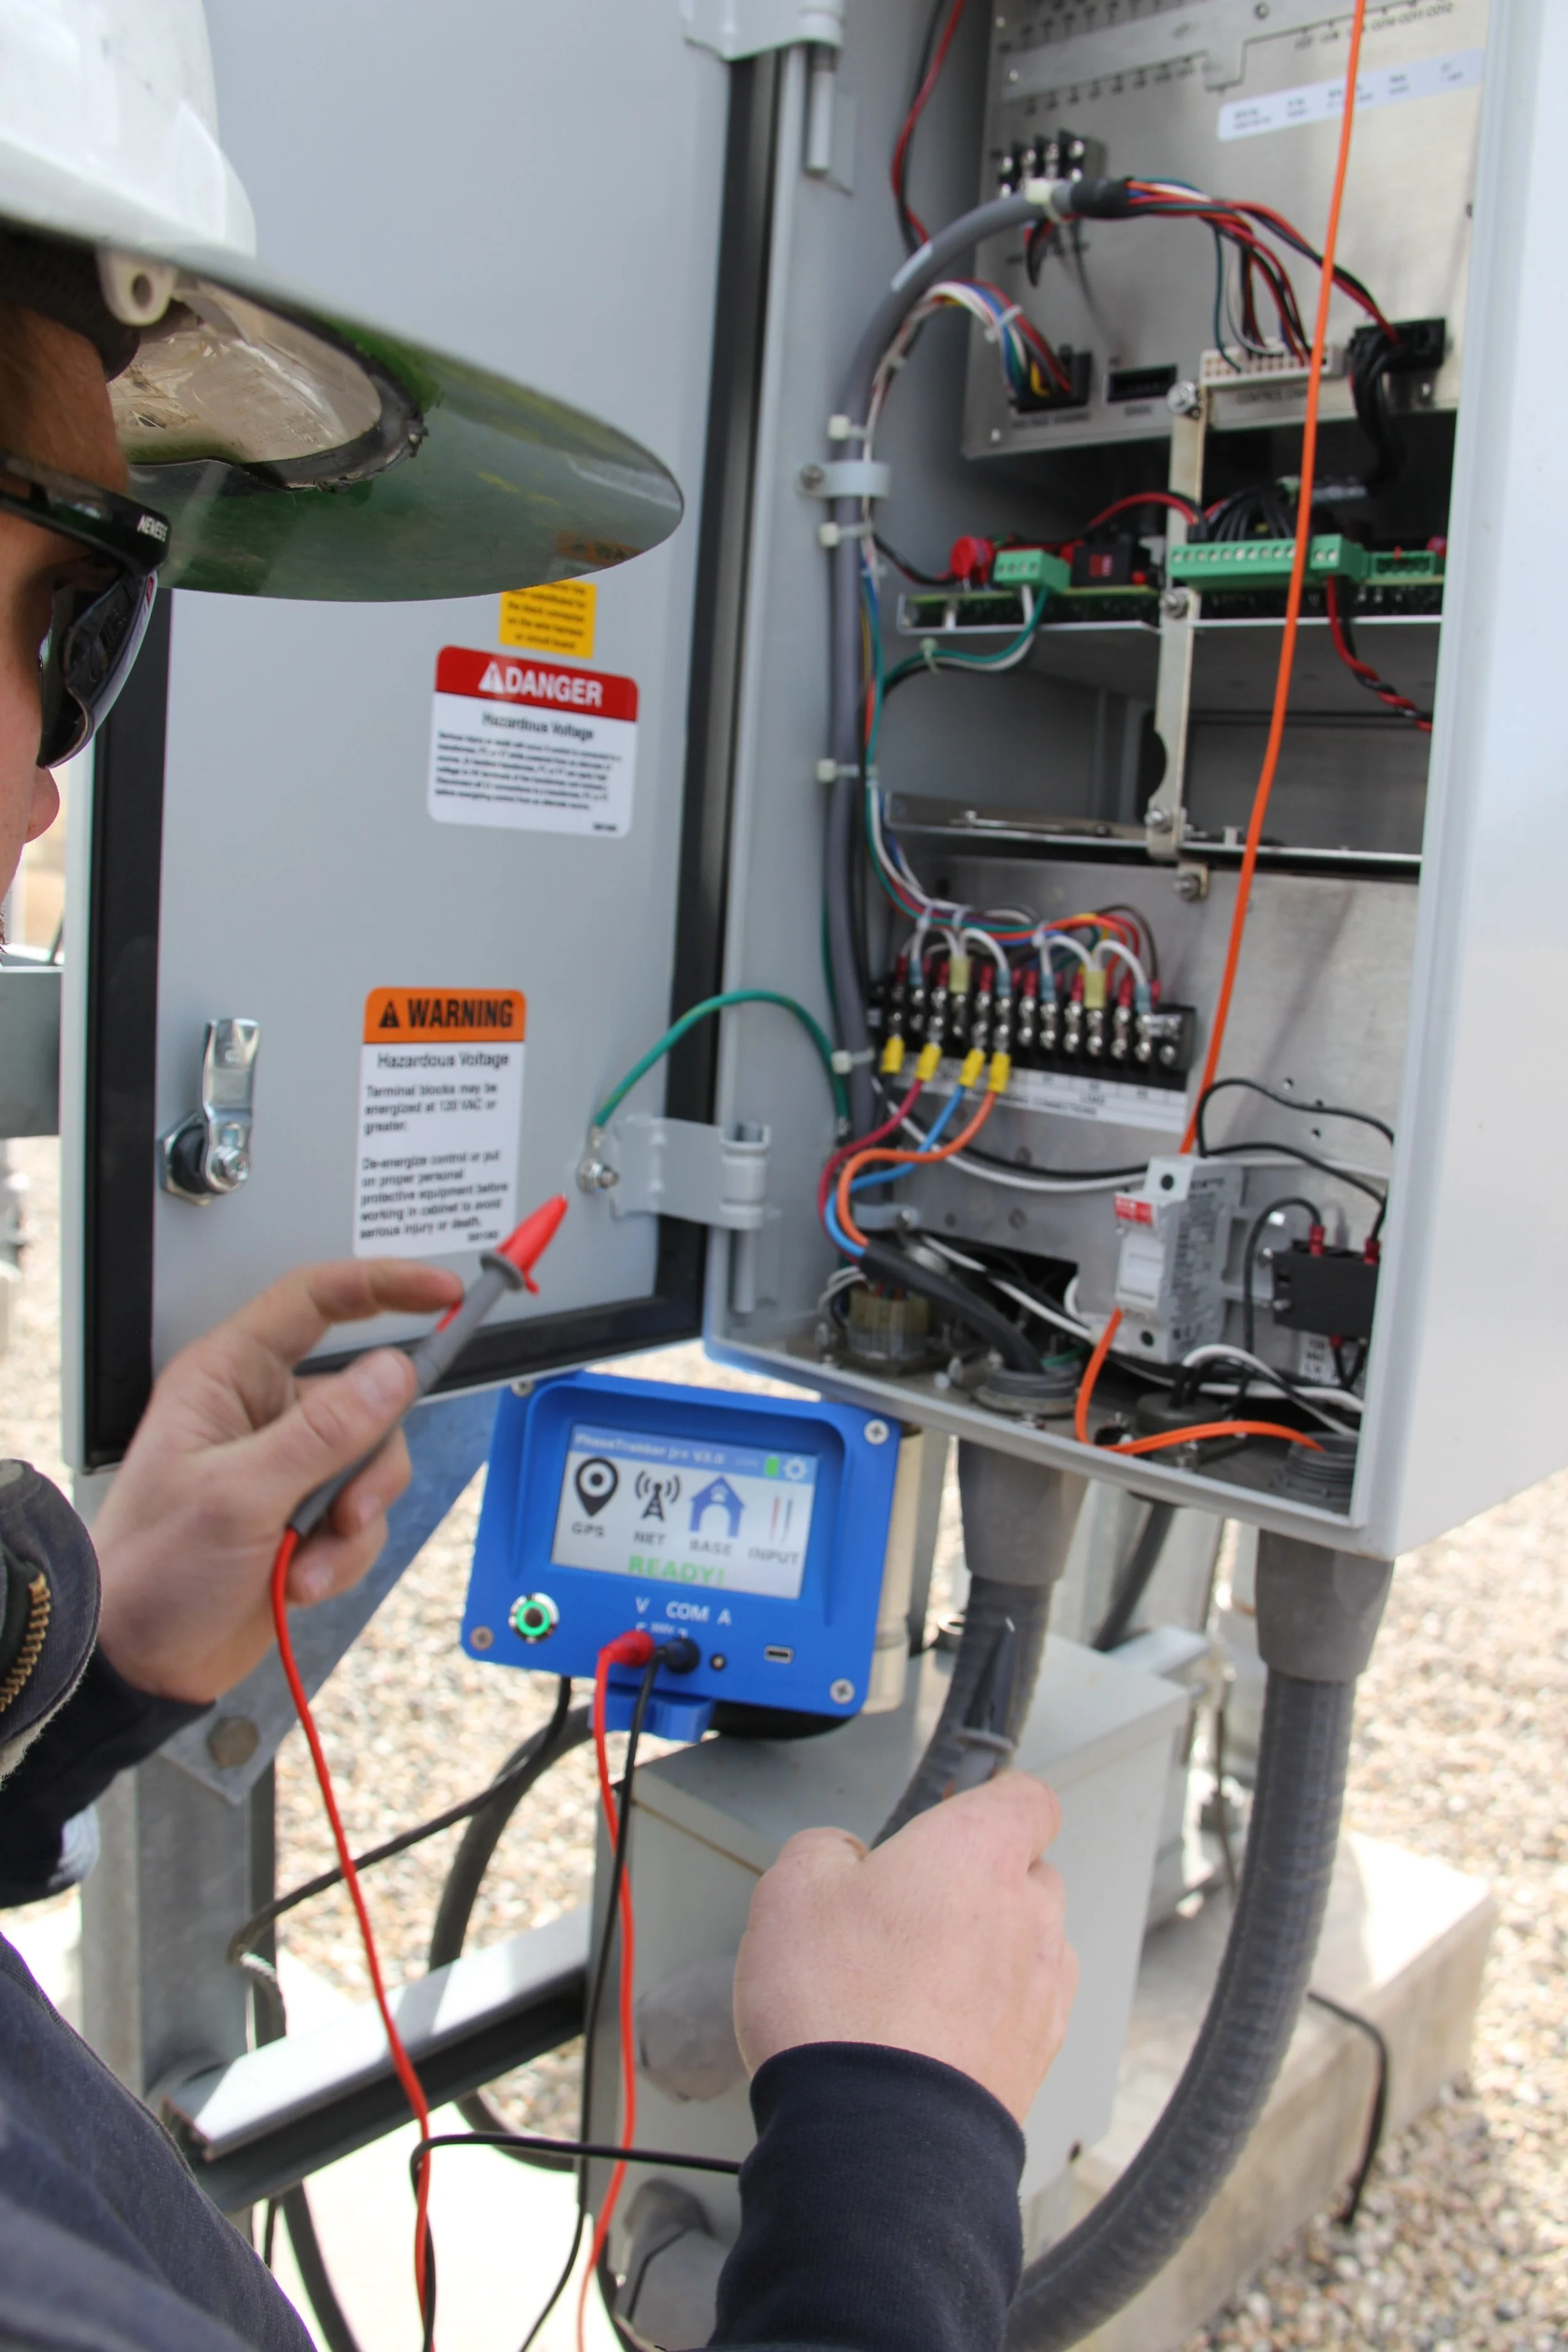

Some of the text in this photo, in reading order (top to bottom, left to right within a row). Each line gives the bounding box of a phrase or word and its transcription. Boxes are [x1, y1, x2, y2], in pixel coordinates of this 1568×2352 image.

[506, 665, 603, 708] DANGER
[482, 712, 594, 741] Hazardous Voltage
[408, 999, 513, 1027] WARNING
[378, 1051, 509, 1069] Hazardous Voltage
[367, 1083, 497, 1097] Terminal blocks may be
[365, 1102, 421, 1117] energized
[426, 1102, 435, 1112] at
[486, 1100, 496, 1109] or
[363, 1150, 499, 1170] De-energize control or put
[362, 1170, 463, 1188] on proper personal
[361, 1181, 507, 1205] protective equipment before
[361, 1208, 403, 1222] working
[409, 1207, 417, 1217] in
[421, 1203, 458, 1216] cabinet
[475, 1199, 501, 1210] avoid
[360, 1225, 400, 1239] serious
[405, 1222, 433, 1236] injury
[439, 1222, 447, 1230] or
[571, 1521, 605, 1538] GPS
[633, 1530, 666, 1547] NET
[691, 1539, 733, 1557] BASE
[748, 1546, 800, 1565] INPUT
[628, 1555, 726, 1587] READY!
[635, 1596, 732, 1626] V COM A
